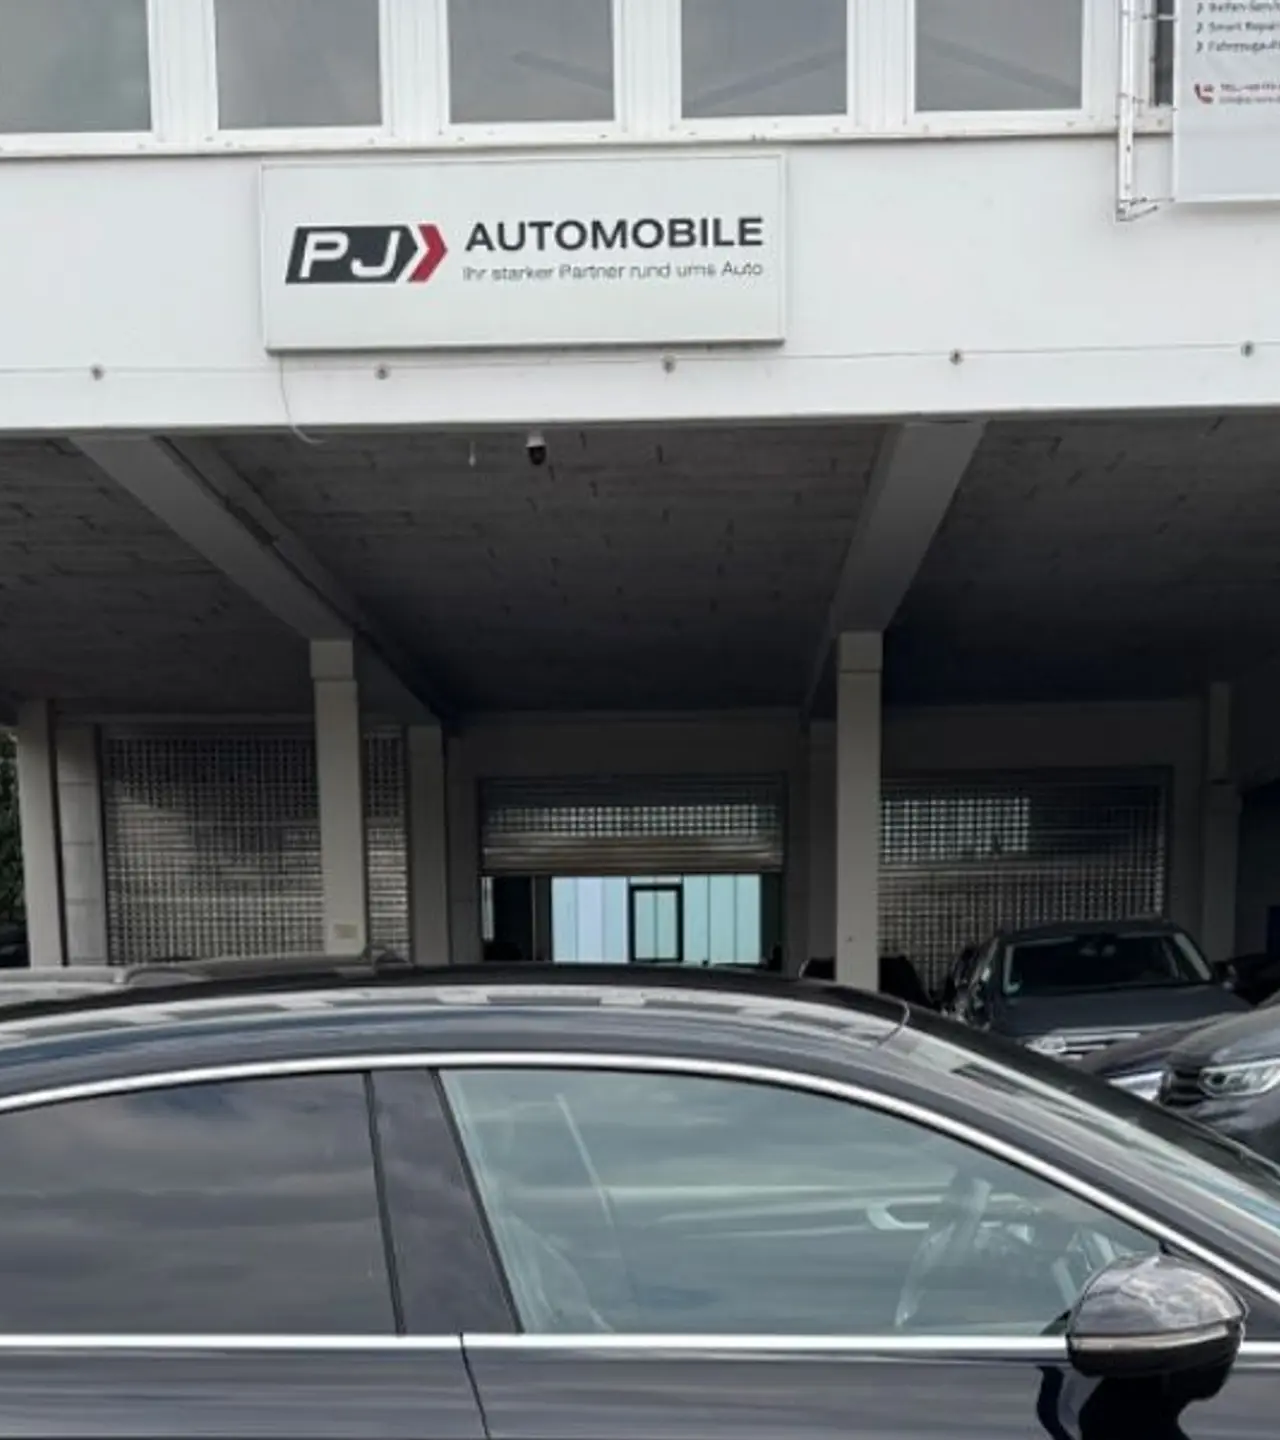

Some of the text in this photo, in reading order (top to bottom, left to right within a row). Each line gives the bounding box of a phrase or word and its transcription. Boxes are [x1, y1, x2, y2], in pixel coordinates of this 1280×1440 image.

[299, 217, 764, 278] PJ AUTOMOBILE
[462, 261, 763, 281] Ihr starker Partner rund ums Auto
